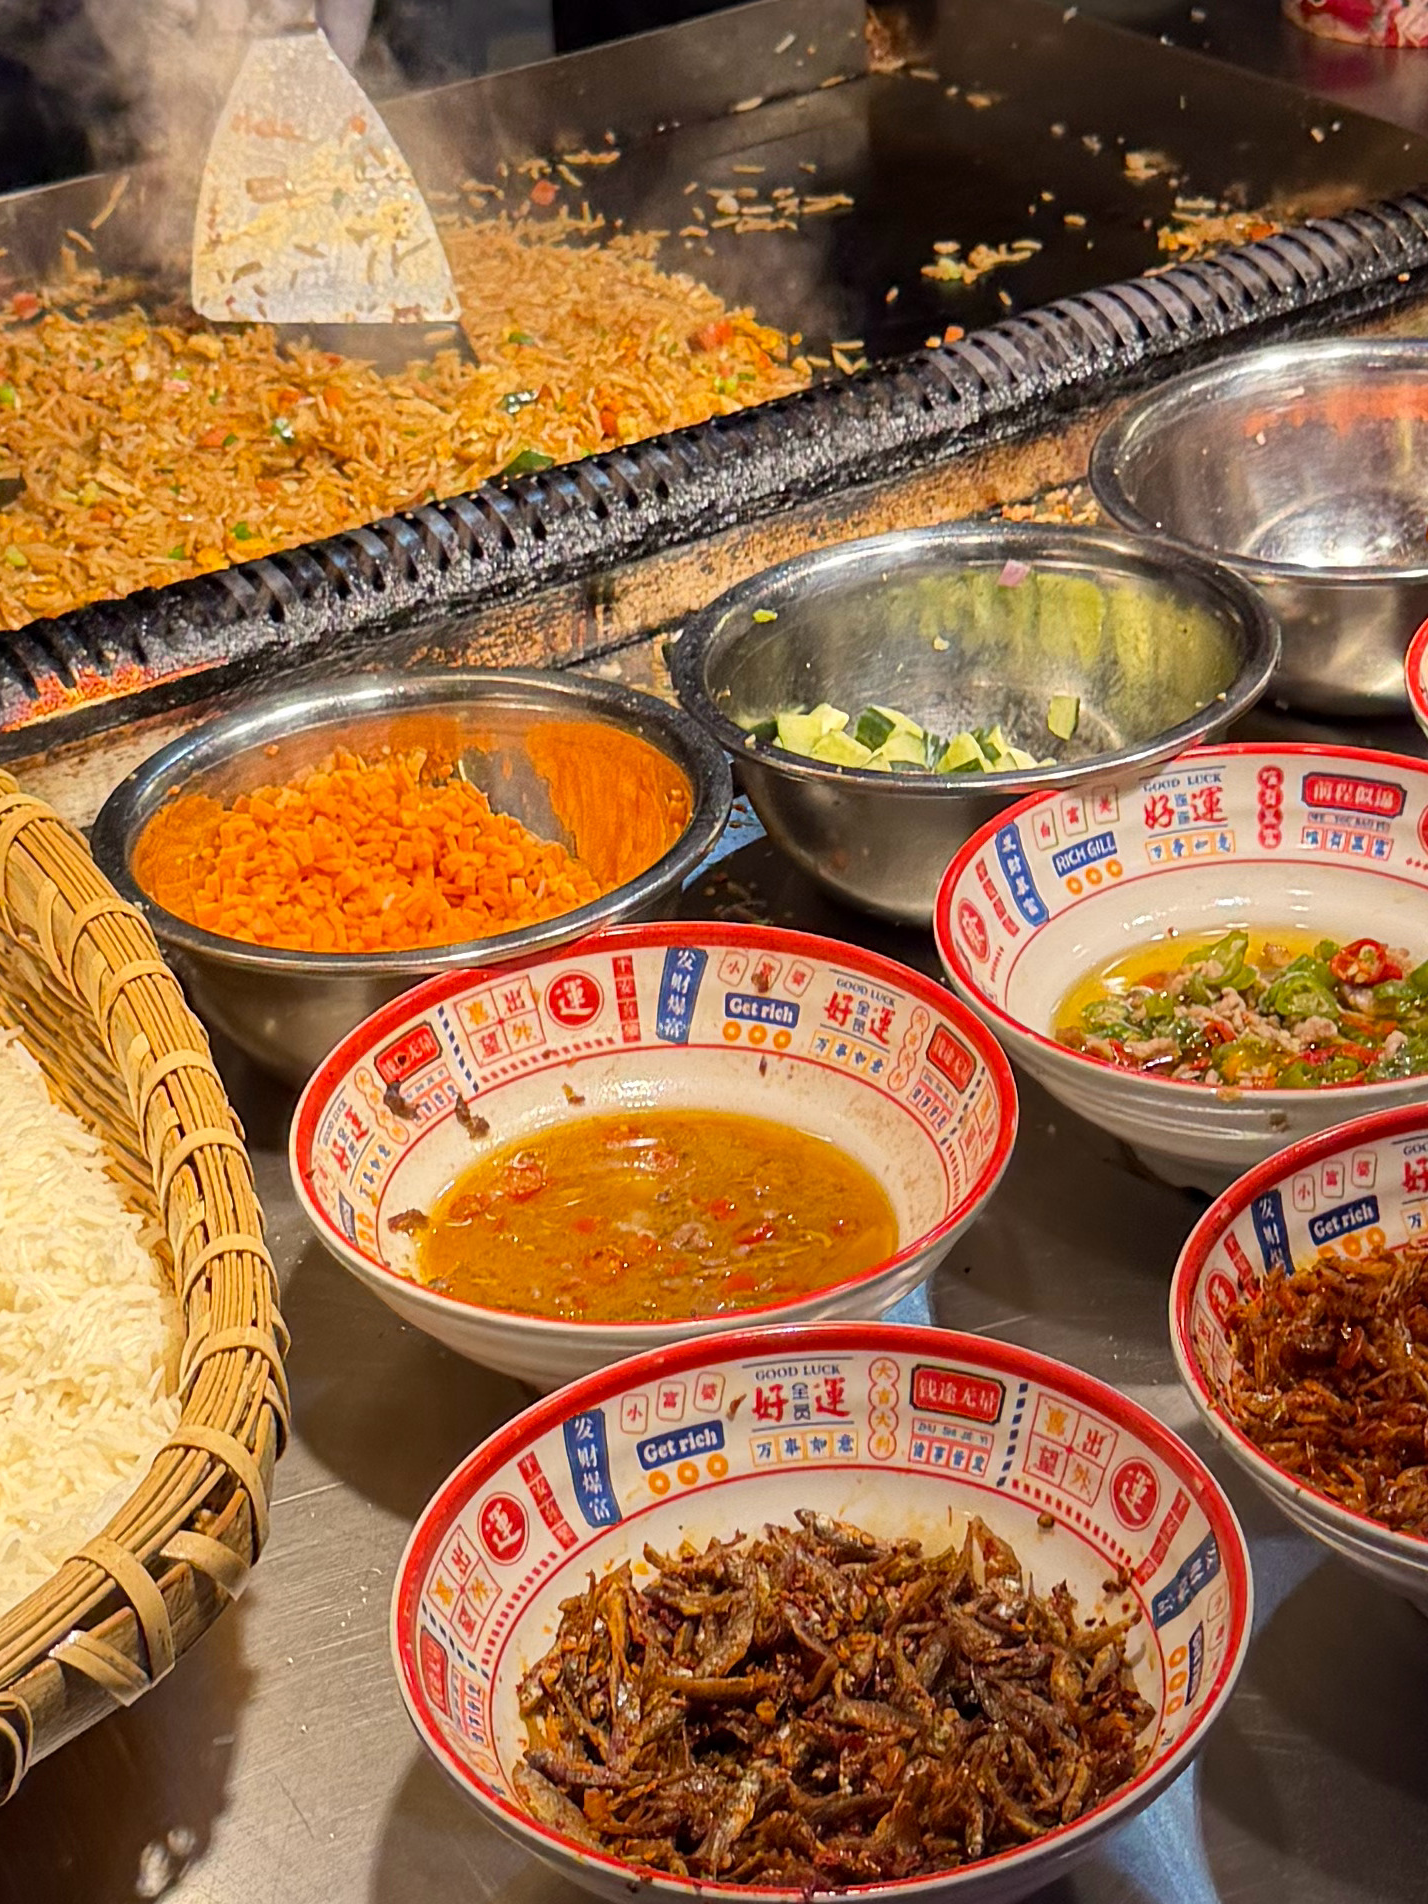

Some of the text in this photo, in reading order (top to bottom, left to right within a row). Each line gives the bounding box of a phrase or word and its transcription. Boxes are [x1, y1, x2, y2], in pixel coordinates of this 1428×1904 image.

[729, 997, 794, 1024] Get rich
[836, 977, 897, 1008] GOOD LUCK
[824, 991, 896, 1046] 好運
[1314, 1203, 1374, 1239] Get rich
[755, 1362, 841, 1383] GOOD LUCK
[752, 1376, 852, 1424] 好運
[643, 1427, 718, 1465] Get rich
